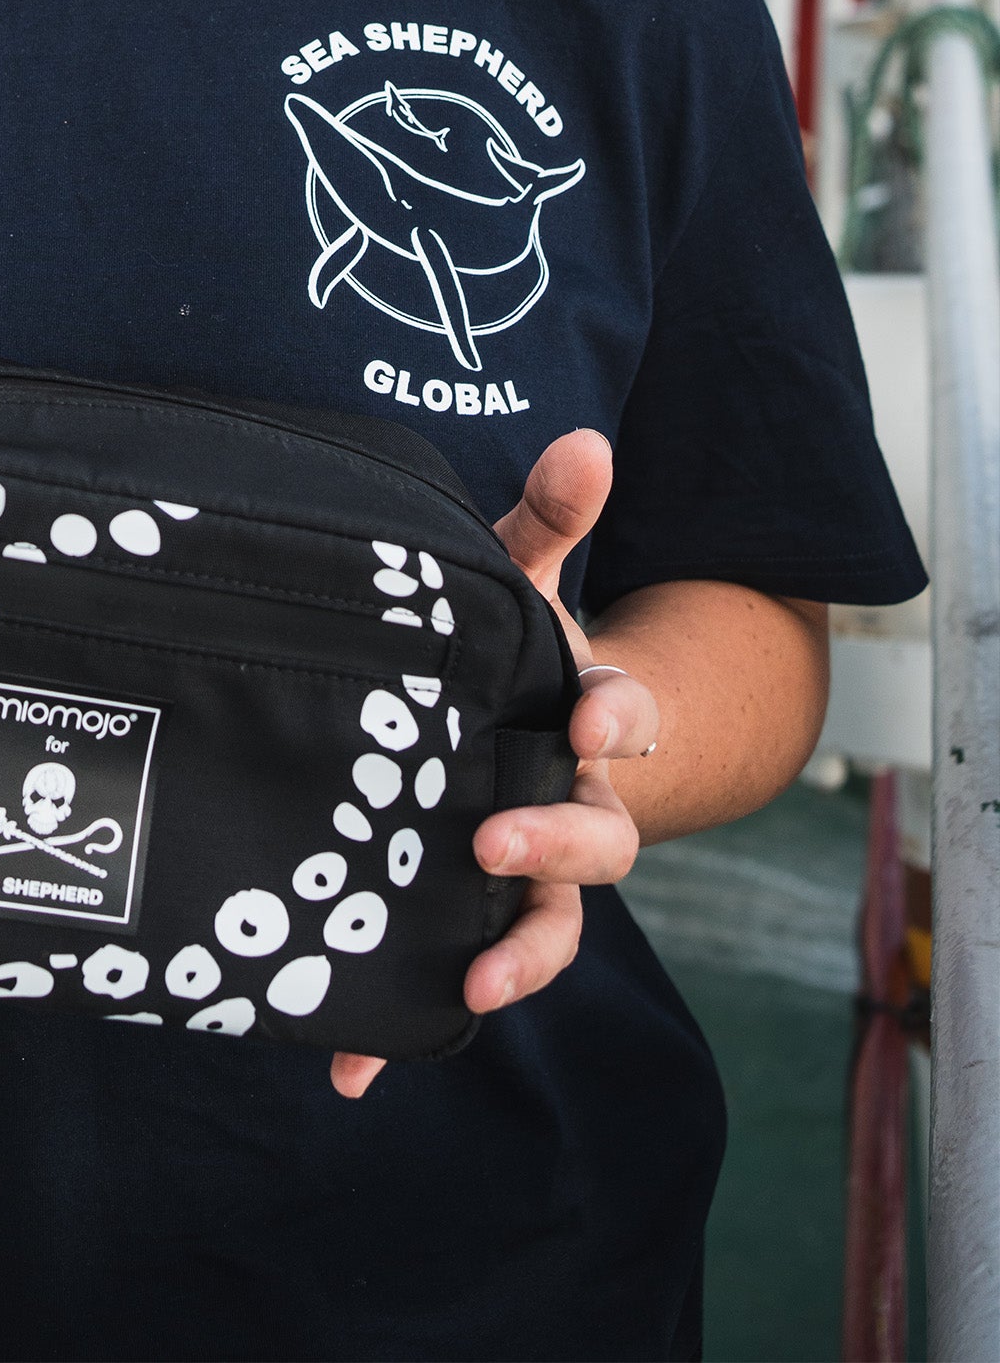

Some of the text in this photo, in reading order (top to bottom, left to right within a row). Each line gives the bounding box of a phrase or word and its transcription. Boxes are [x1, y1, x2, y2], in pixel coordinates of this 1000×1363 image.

[281, 22, 564, 137] SEA SHEPHERD
[363, 360, 530, 416] GLOBAL
[45, 735, 70, 754] for
[2, 877, 104, 906] SHEPHERD
